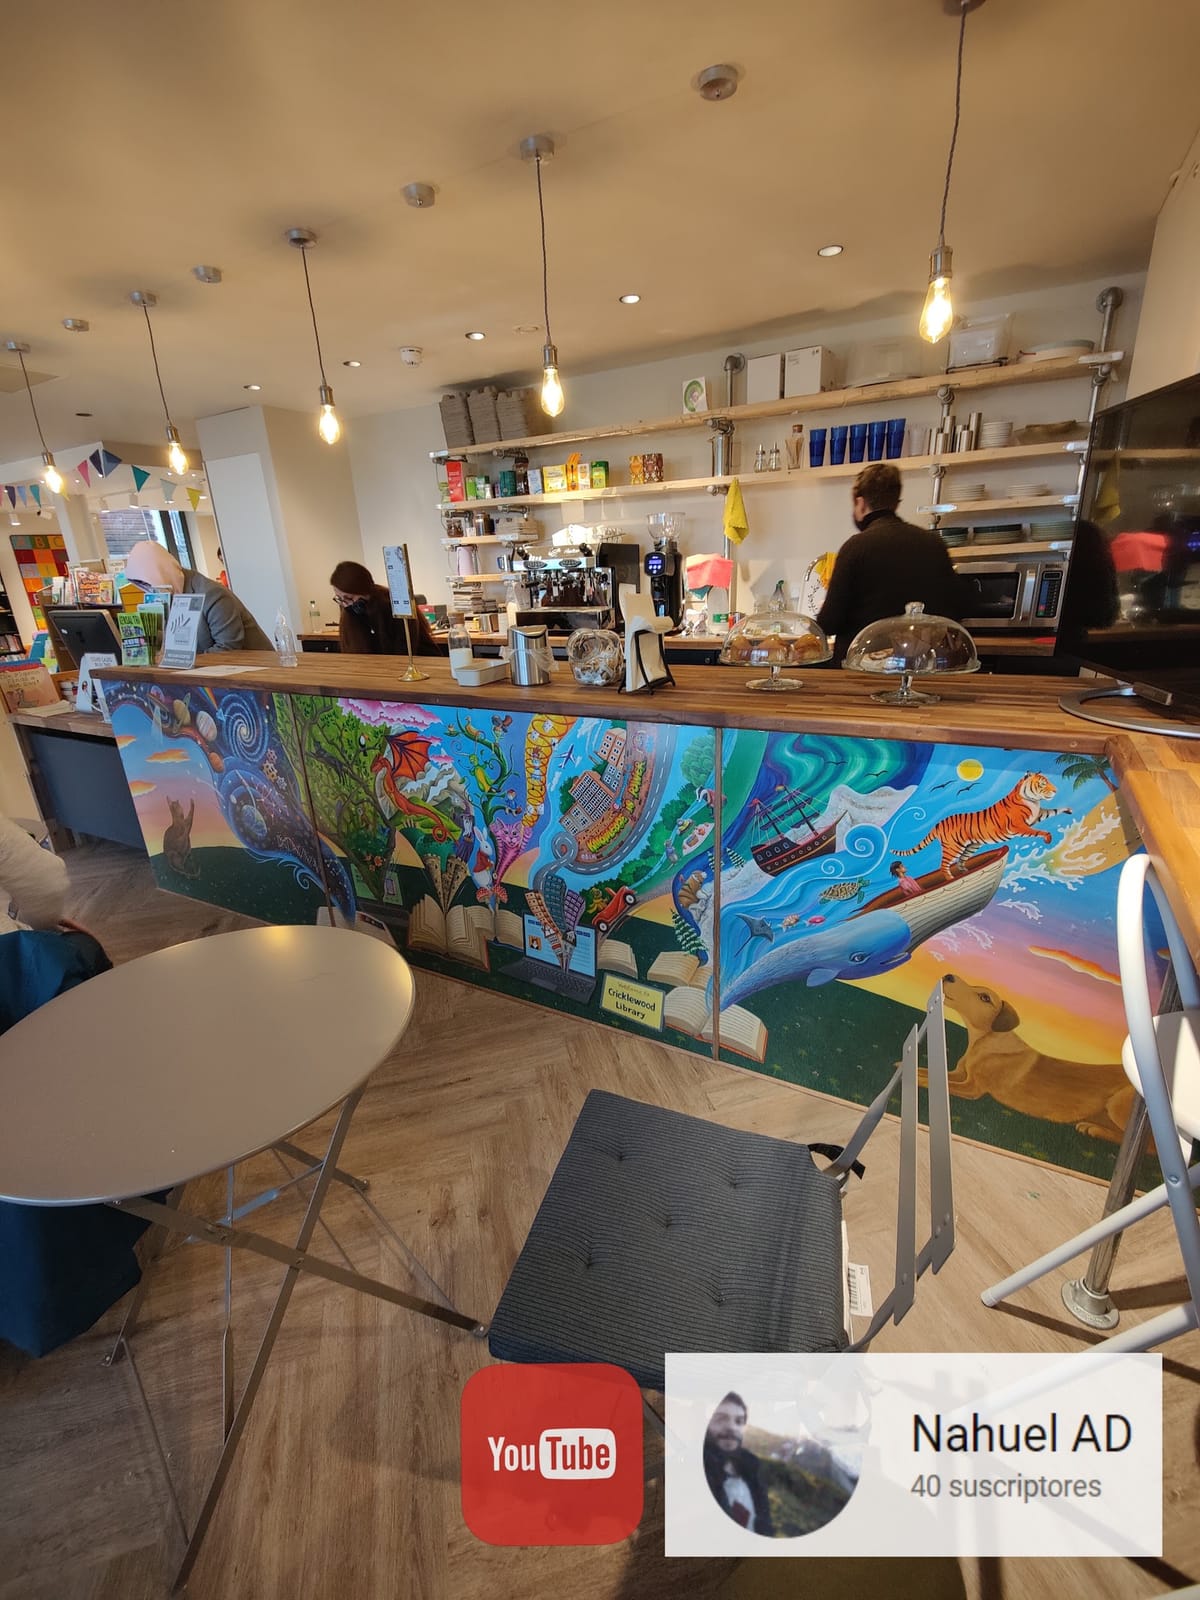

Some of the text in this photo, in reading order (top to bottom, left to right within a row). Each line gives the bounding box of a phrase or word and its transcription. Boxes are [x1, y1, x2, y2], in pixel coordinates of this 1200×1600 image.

[628, 760, 647, 800] POWER
[608, 987, 656, 1012] Cricklewood
[615, 1001, 645, 1020] Library
